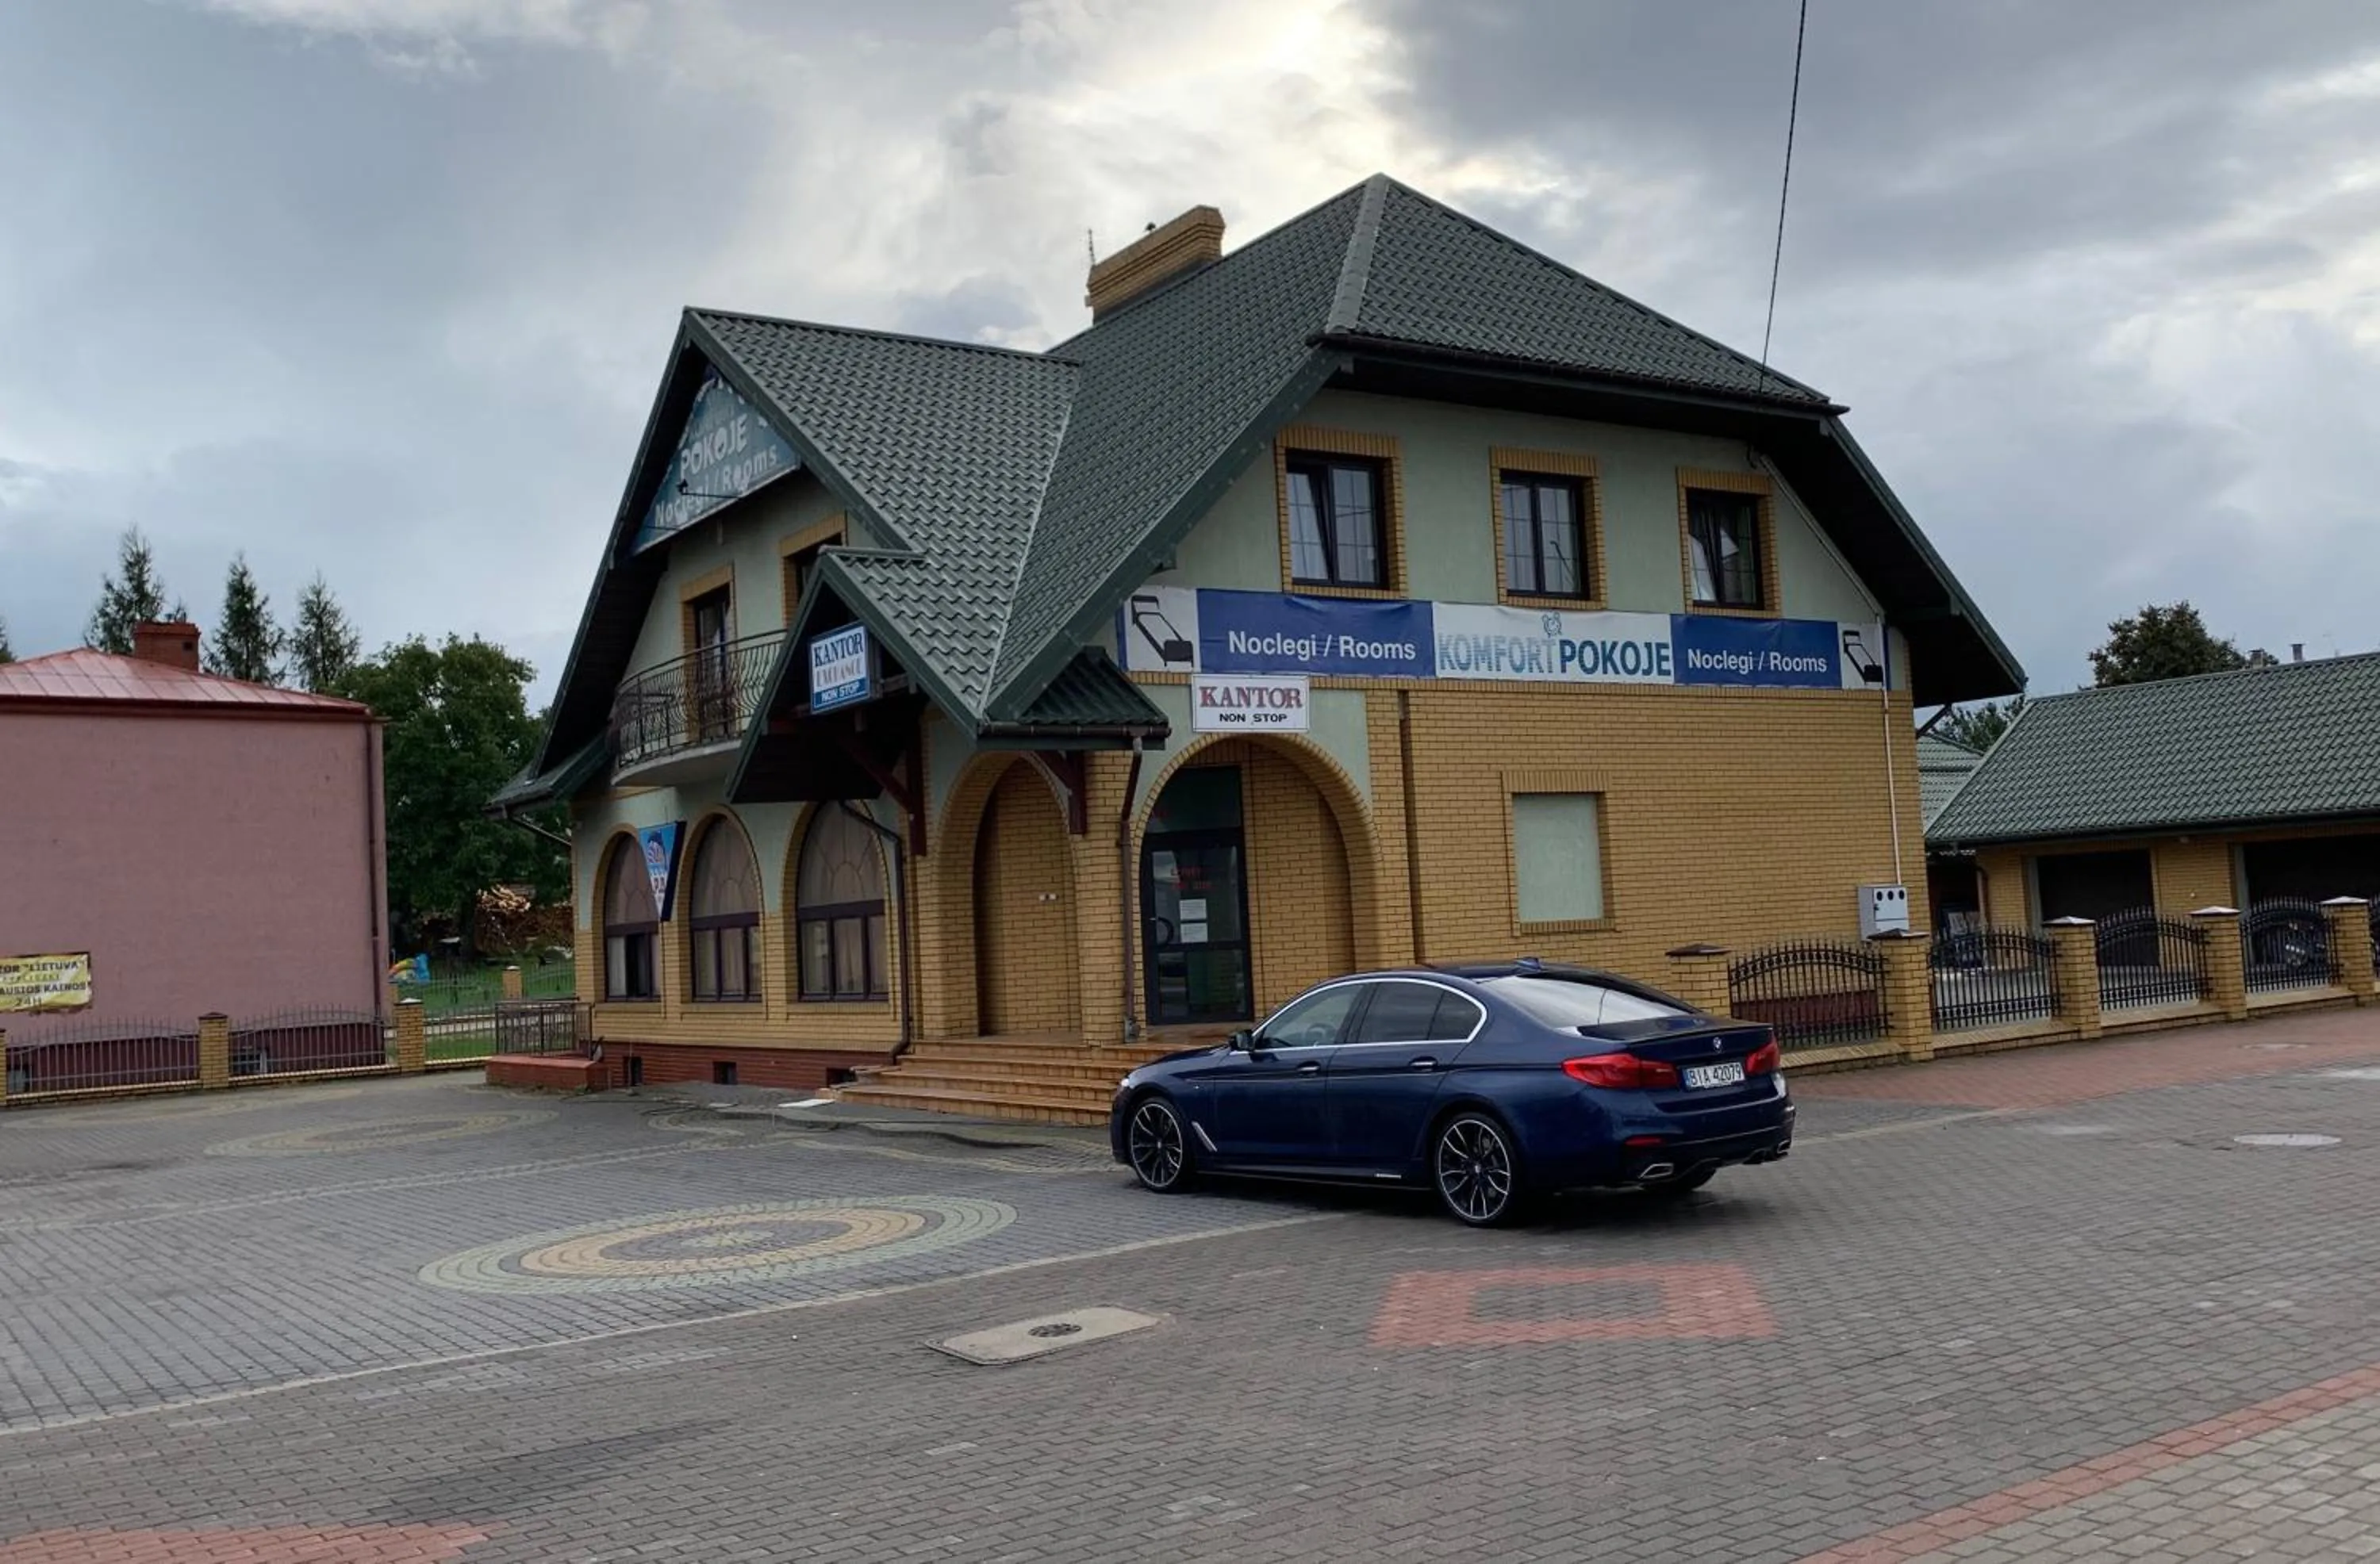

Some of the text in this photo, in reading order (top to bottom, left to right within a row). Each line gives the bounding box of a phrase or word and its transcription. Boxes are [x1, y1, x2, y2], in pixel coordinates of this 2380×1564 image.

[680, 412, 748, 481] POKOJE
[723, 444, 777, 491] Rooms
[814, 632, 864, 668] KANTOR
[1229, 631, 1317, 661] Noclegi
[1339, 635, 1416, 660] Rooms
[1687, 648, 1753, 674] Noclegi
[1770, 652, 1828, 673] Rooms
[821, 680, 860, 703] NON STOP
[1199, 685, 1303, 709] KANTOR
[1219, 713, 1288, 723] NON STOP
[1713, 1064, 1741, 1082] 42079
